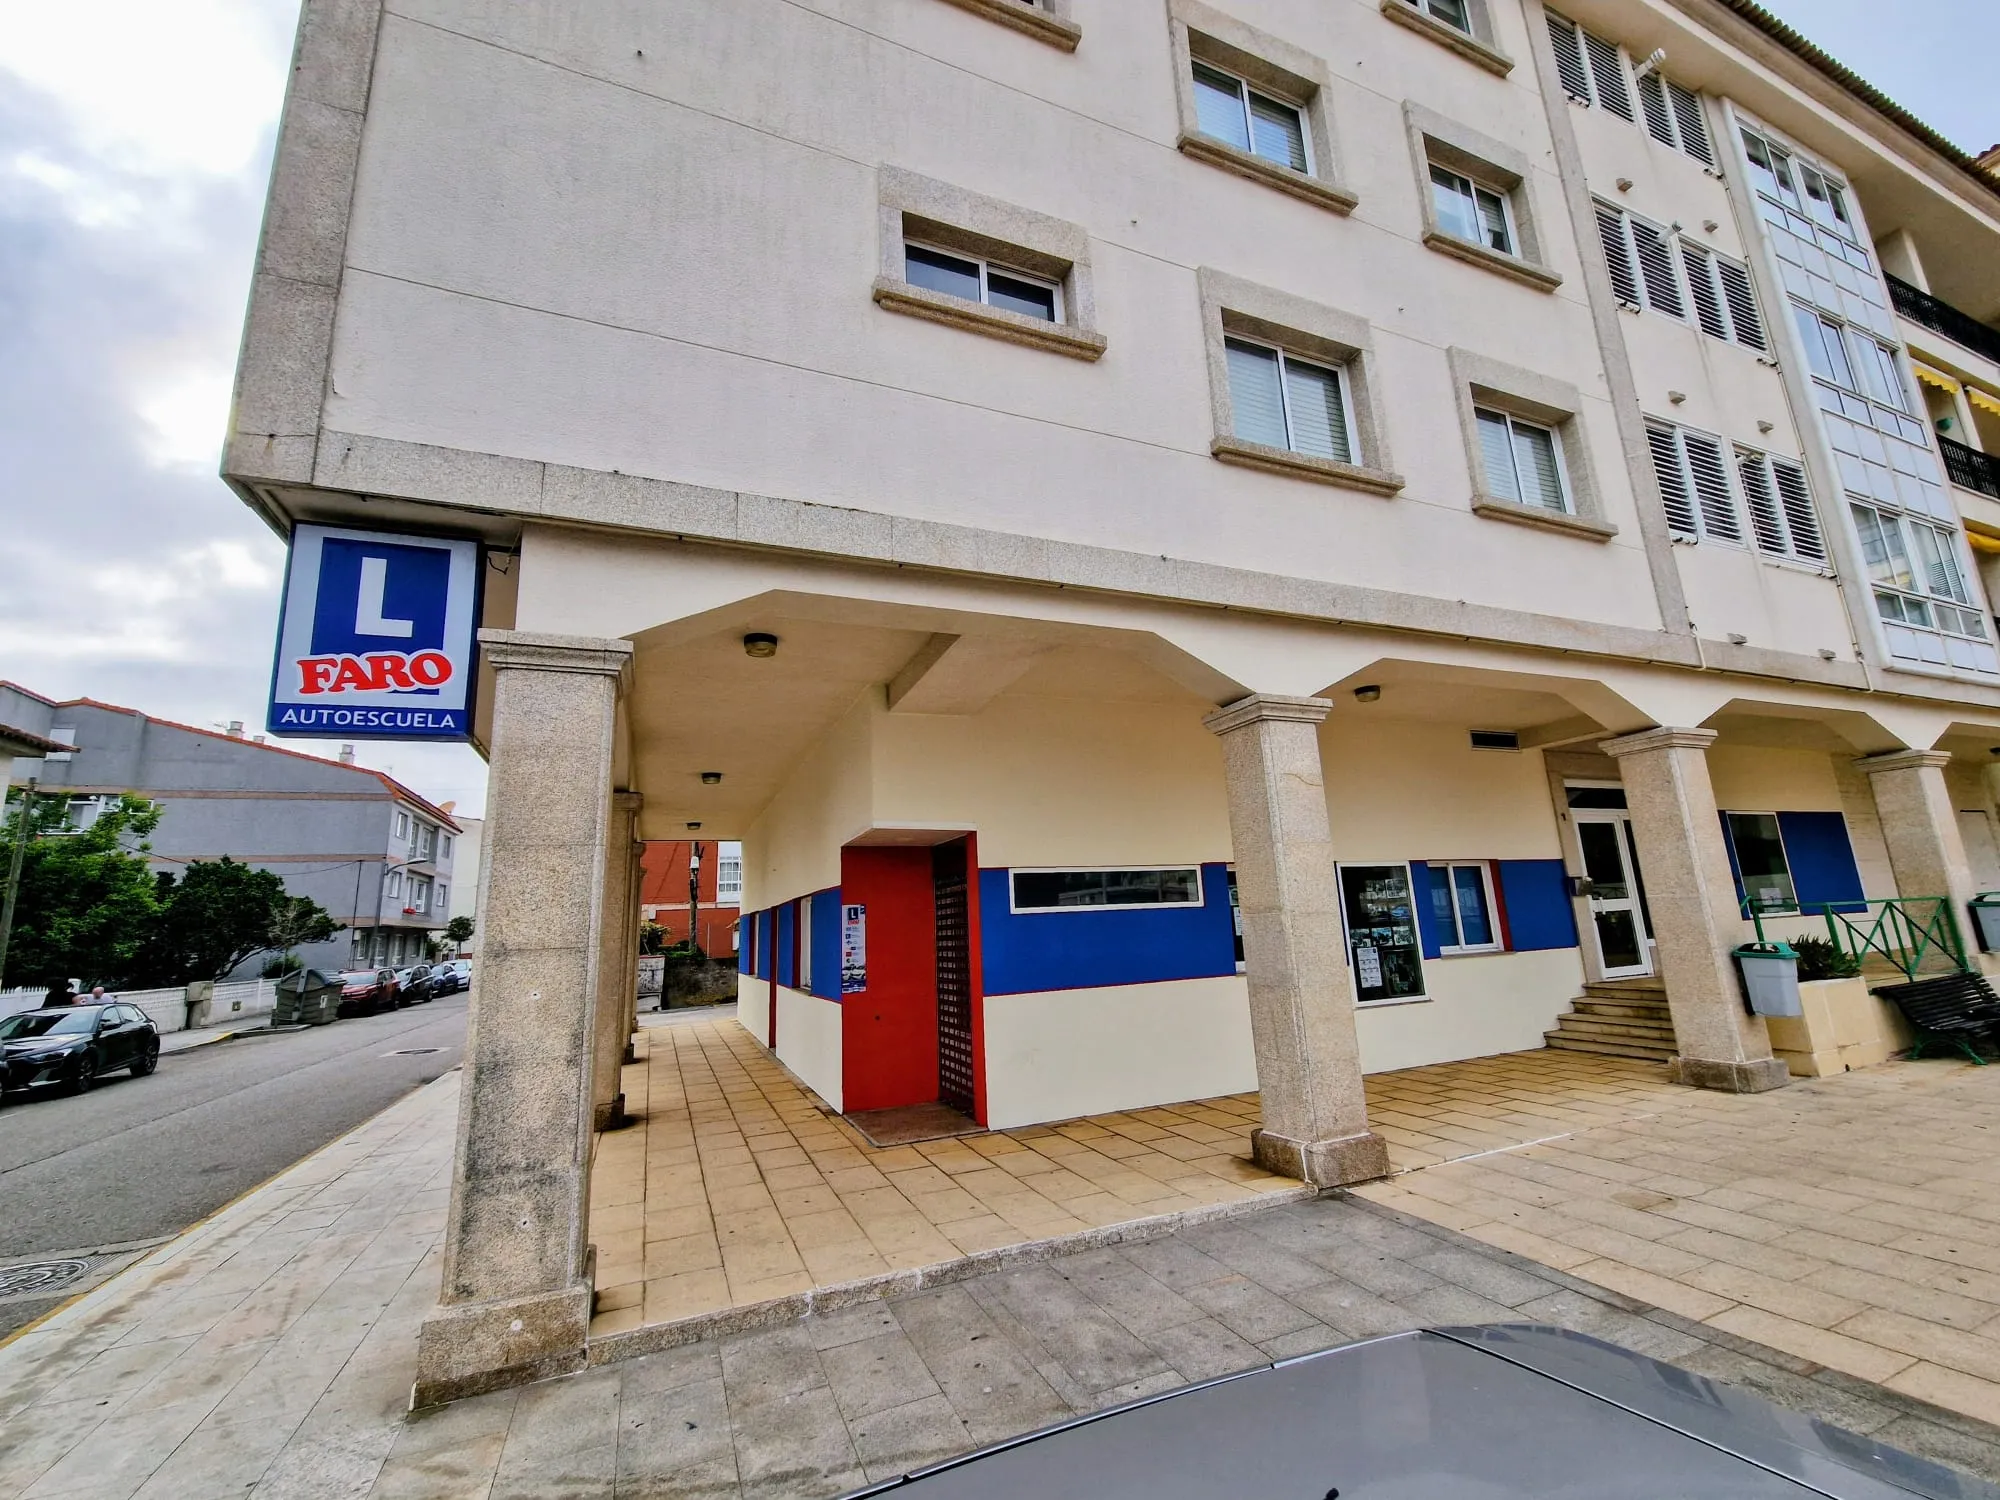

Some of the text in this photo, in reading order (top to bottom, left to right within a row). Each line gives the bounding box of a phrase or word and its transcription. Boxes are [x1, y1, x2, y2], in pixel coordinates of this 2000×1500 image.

[354, 557, 414, 638] L
[296, 652, 453, 695] FARO
[281, 708, 456, 729] AUTOESCUELA
